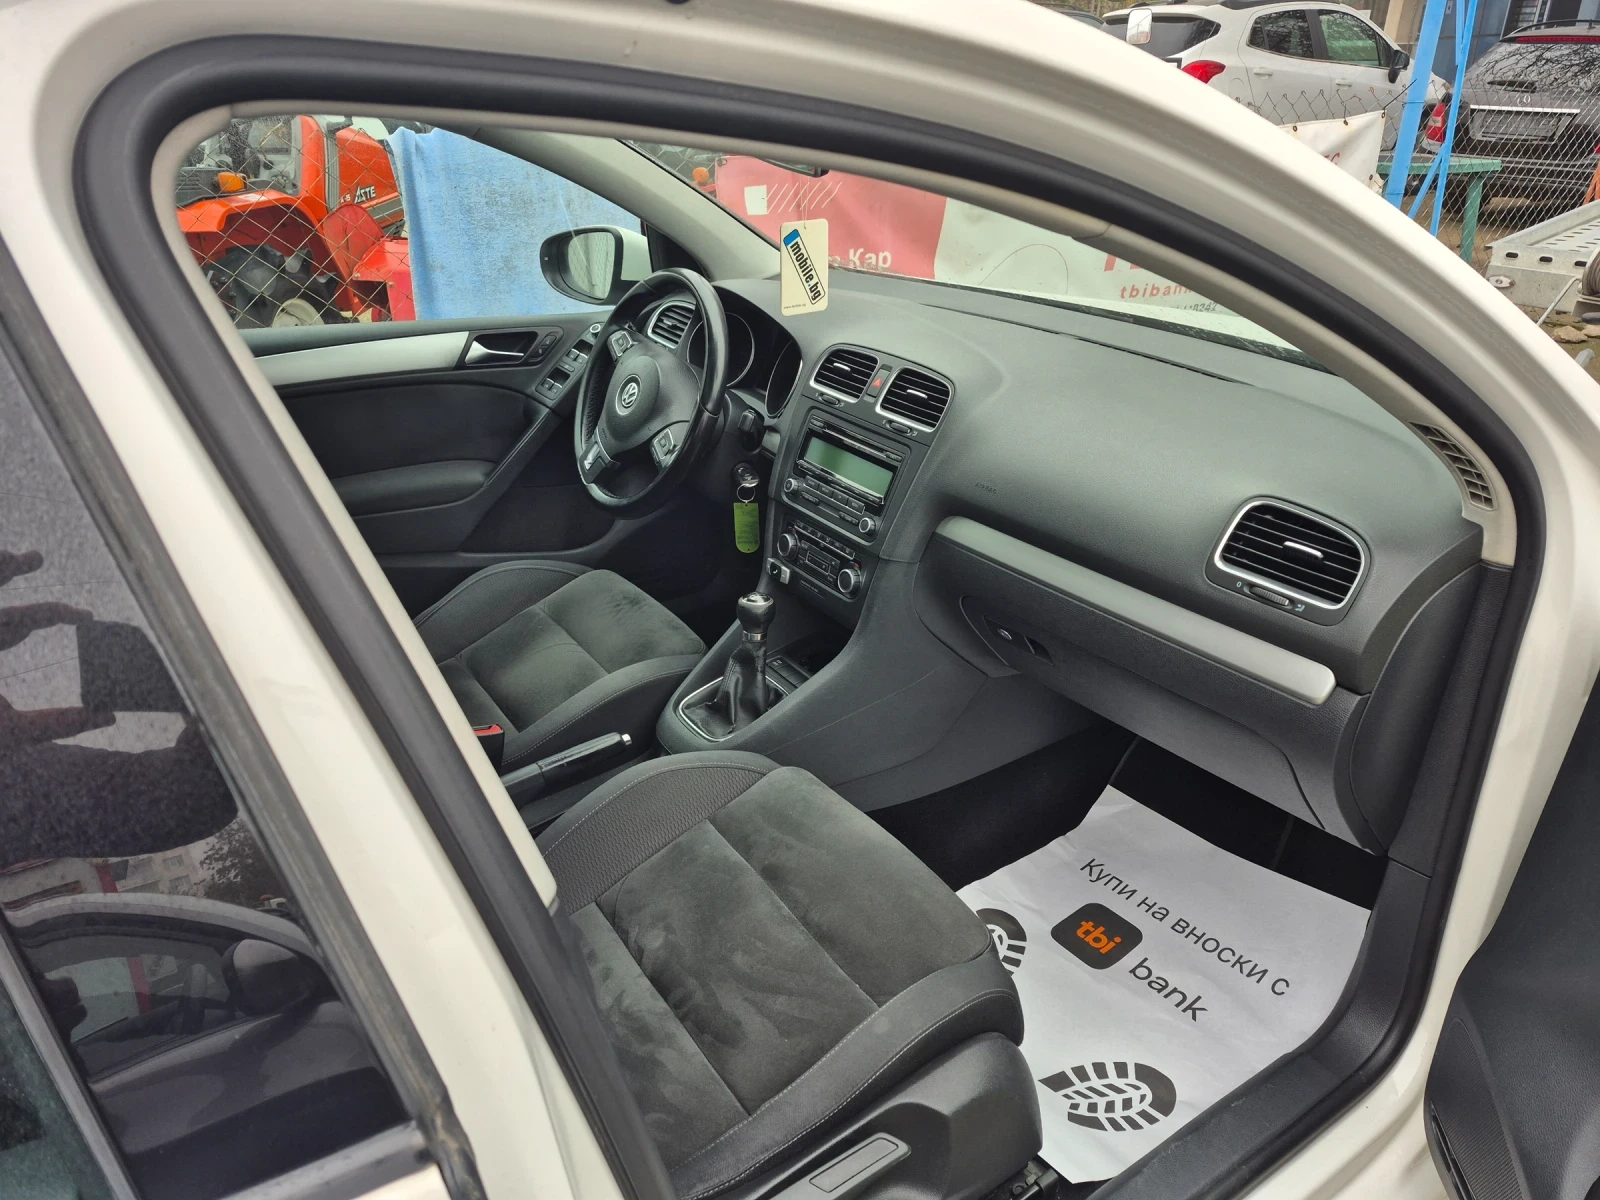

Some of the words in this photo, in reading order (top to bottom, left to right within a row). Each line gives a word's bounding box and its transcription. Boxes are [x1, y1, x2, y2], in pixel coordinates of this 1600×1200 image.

[789, 240, 822, 302] mobile.bg
[1076, 920, 1122, 954] tbi
[1128, 957, 1208, 1022] bank
[1080, 858, 1138, 900] Купи
[1136, 896, 1170, 922] на
[1170, 917, 1269, 984] вноски
[1270, 977, 1290, 996] с
